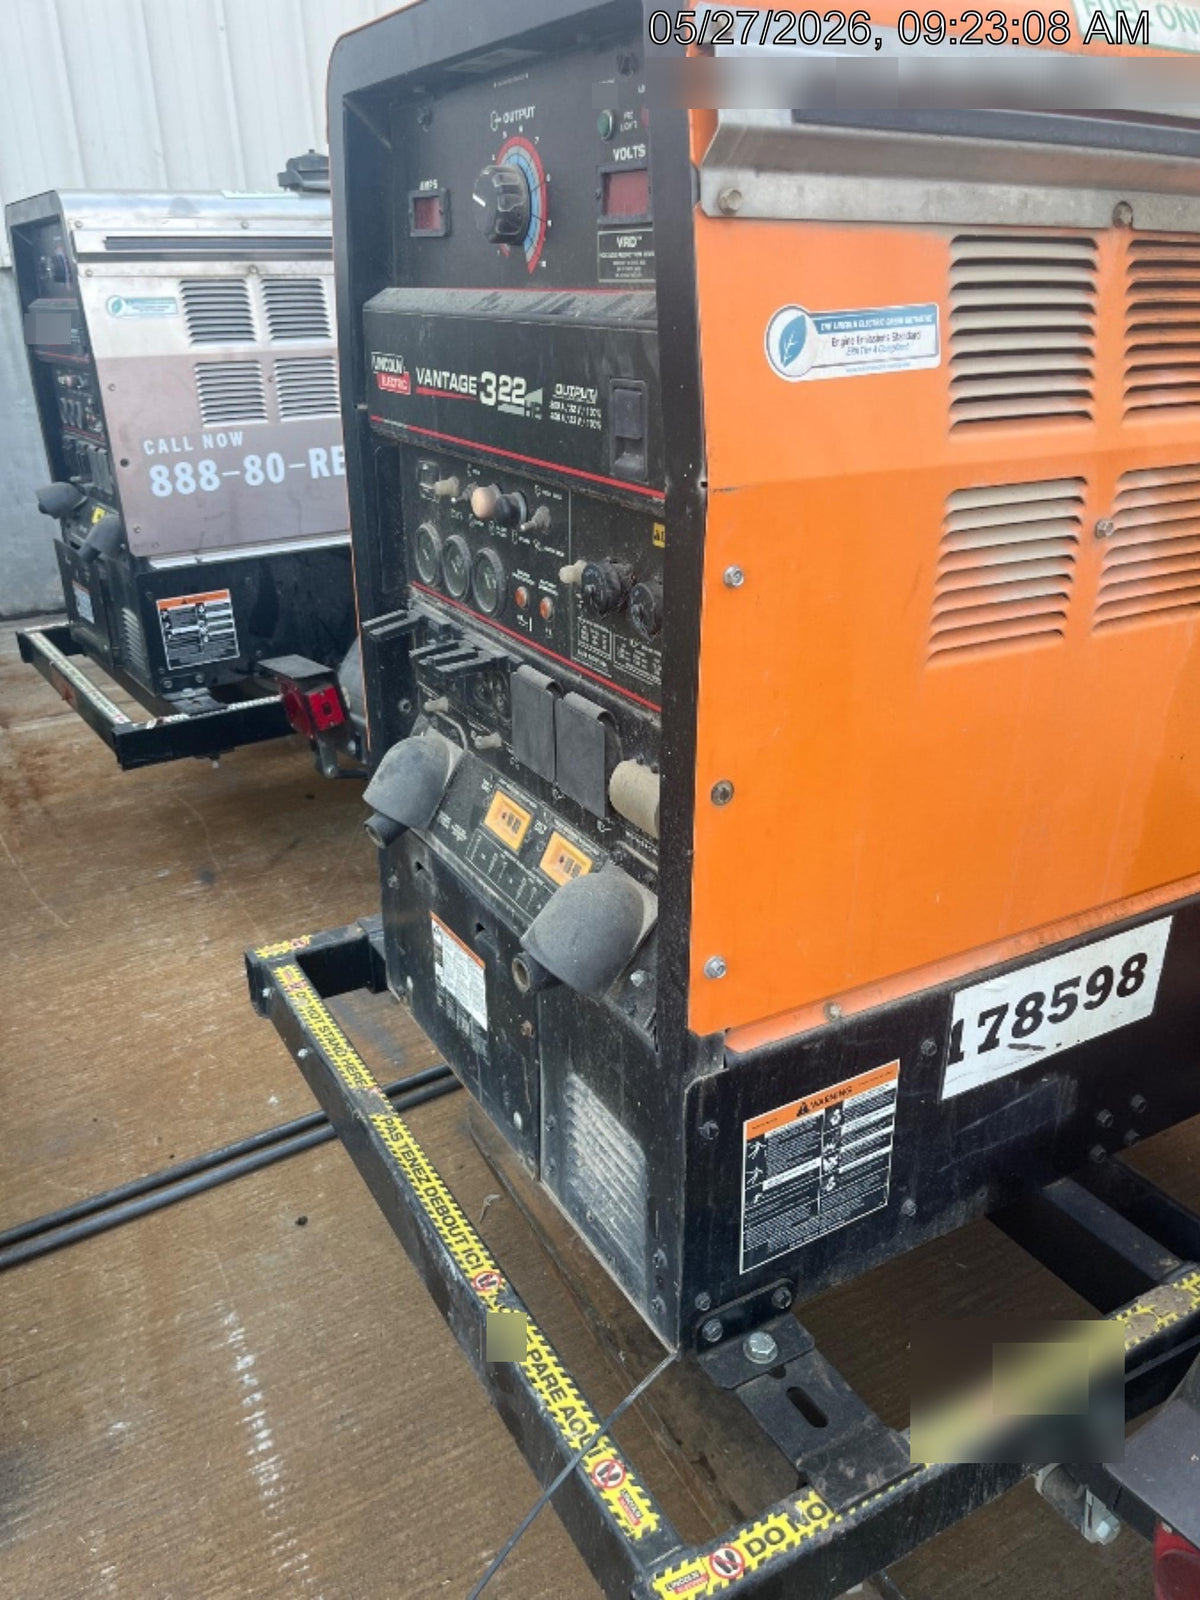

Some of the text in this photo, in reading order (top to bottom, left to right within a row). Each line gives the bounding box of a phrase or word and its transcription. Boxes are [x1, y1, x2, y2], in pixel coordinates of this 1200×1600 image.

[502, 105, 536, 123] OUTPUT
[612, 143, 646, 161] VOLTS
[415, 366, 527, 407] VANTAGE 322
[143, 431, 244, 456] CALL NOW
[947, 952, 1148, 1067] 178598
[341, 1058, 369, 1087] HERE
[381, 1116, 485, 1271] PAS TENEZ DEBOUT ICI
[527, 1348, 568, 1403] PARE
[744, 1525, 786, 1558] DO
